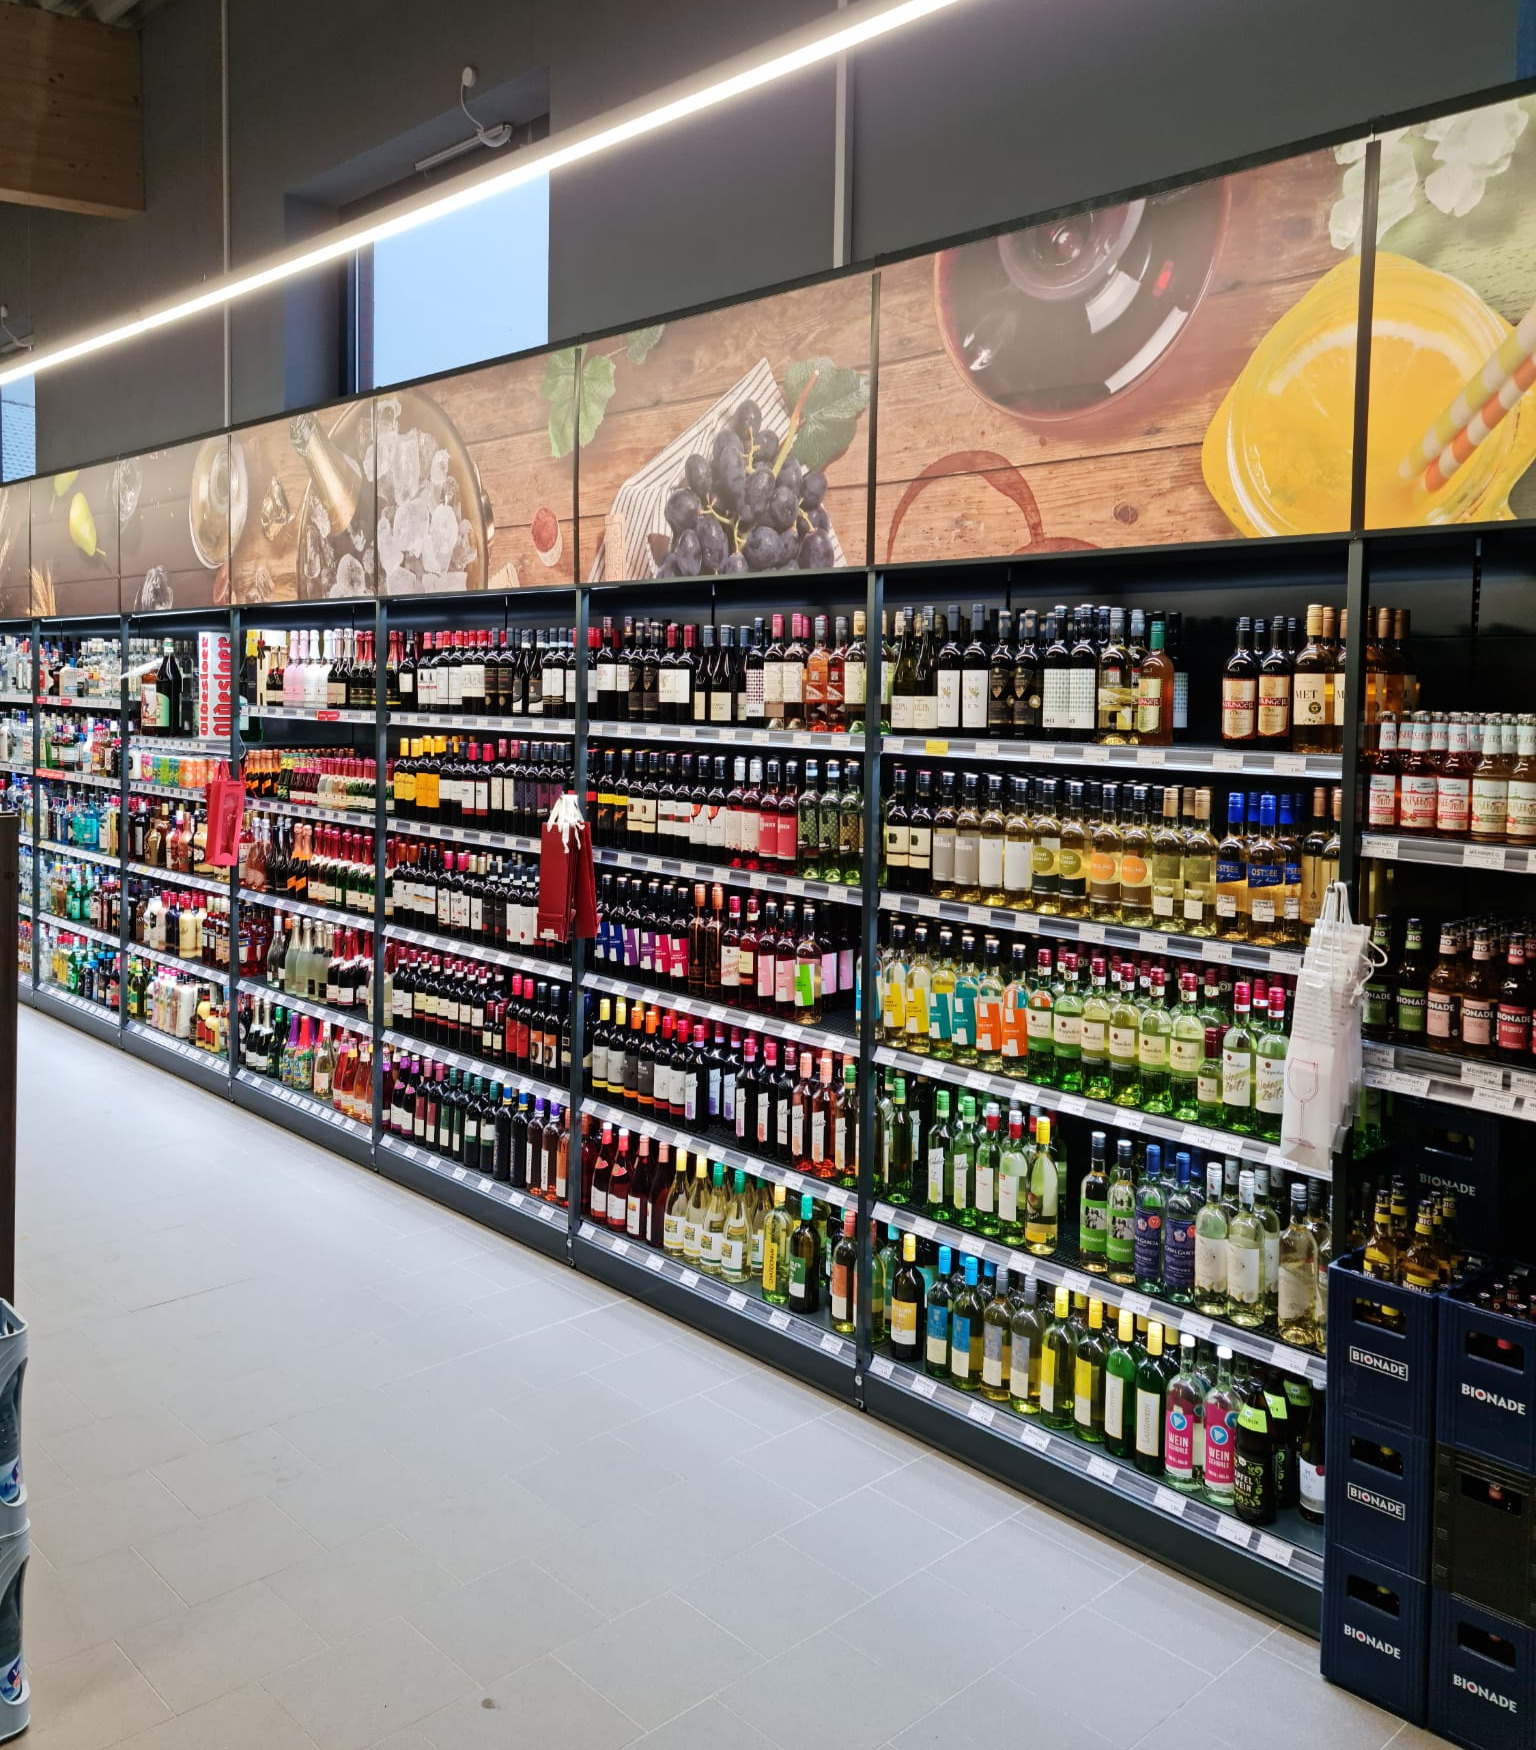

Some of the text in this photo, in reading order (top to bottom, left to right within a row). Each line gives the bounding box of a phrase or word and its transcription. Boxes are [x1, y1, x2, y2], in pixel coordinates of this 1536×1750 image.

[1295, 689, 1318, 700] MET
[1251, 868, 1278, 877] OSTSEE
[1408, 934, 1422, 942] BIO
[1509, 948, 1524, 957] BIO
[1466, 1066, 1498, 1078] MEHRWEG
[1419, 1173, 1476, 1197] BIONADE
[1352, 1350, 1406, 1377] BIONADE
[1461, 1382, 1526, 1415] BIONADE
[1168, 1432, 1189, 1448] WEIN
[1208, 1446, 1230, 1462] WEIN
[1208, 1457, 1230, 1469] SCHORLE
[1235, 1477, 1252, 1493] WEIN
[1350, 1486, 1403, 1516] BIONADE
[1343, 1623, 1401, 1660] BIONADE
[1453, 1673, 1518, 1713] BIONADE
